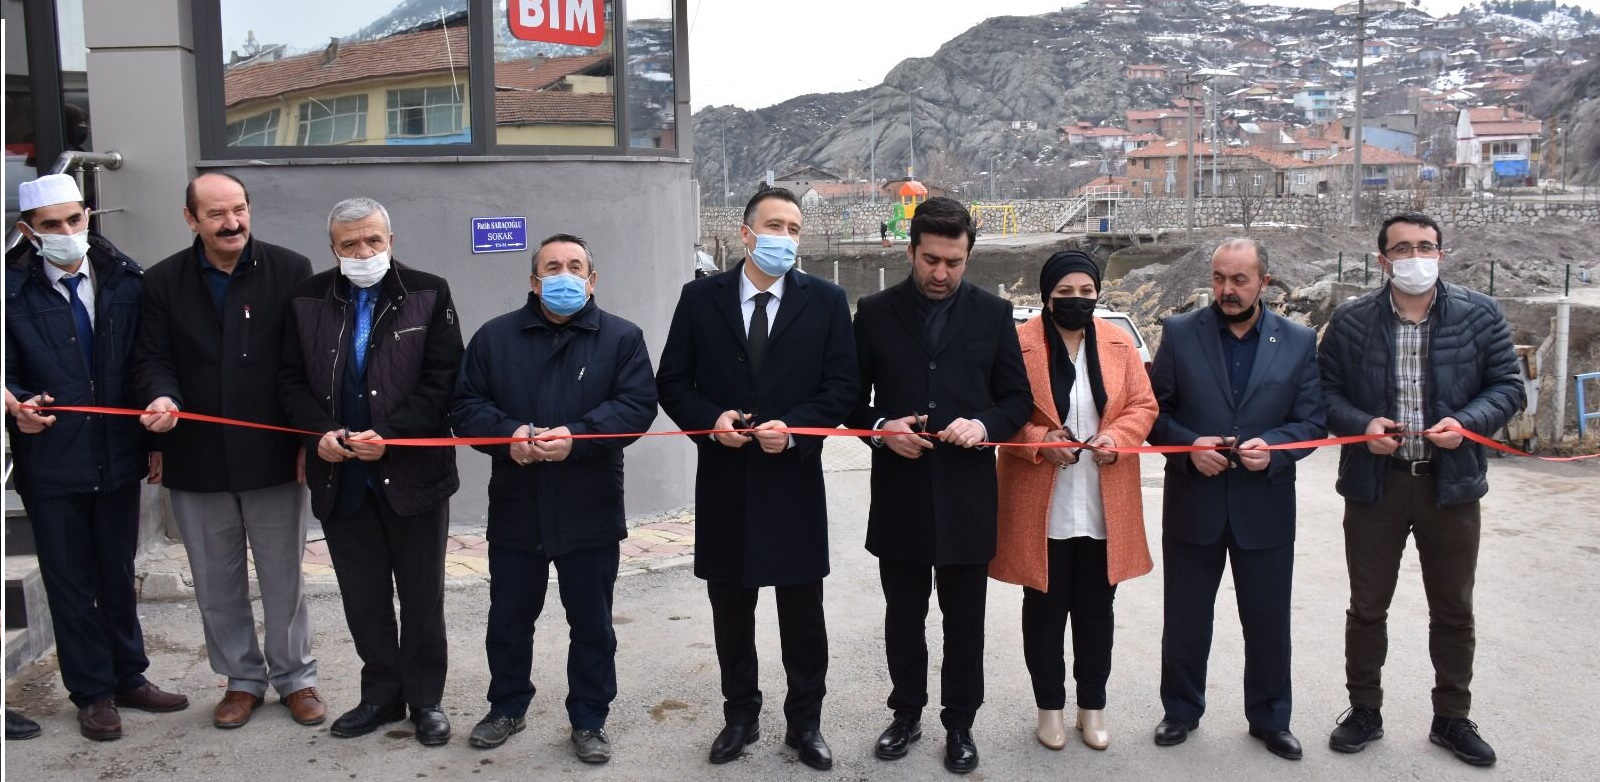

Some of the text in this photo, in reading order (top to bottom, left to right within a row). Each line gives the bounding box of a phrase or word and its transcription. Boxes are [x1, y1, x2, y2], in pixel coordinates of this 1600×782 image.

[477, 219, 522, 231] Fatih SARAÇOĞLU
[487, 232, 514, 241] SOKAK
